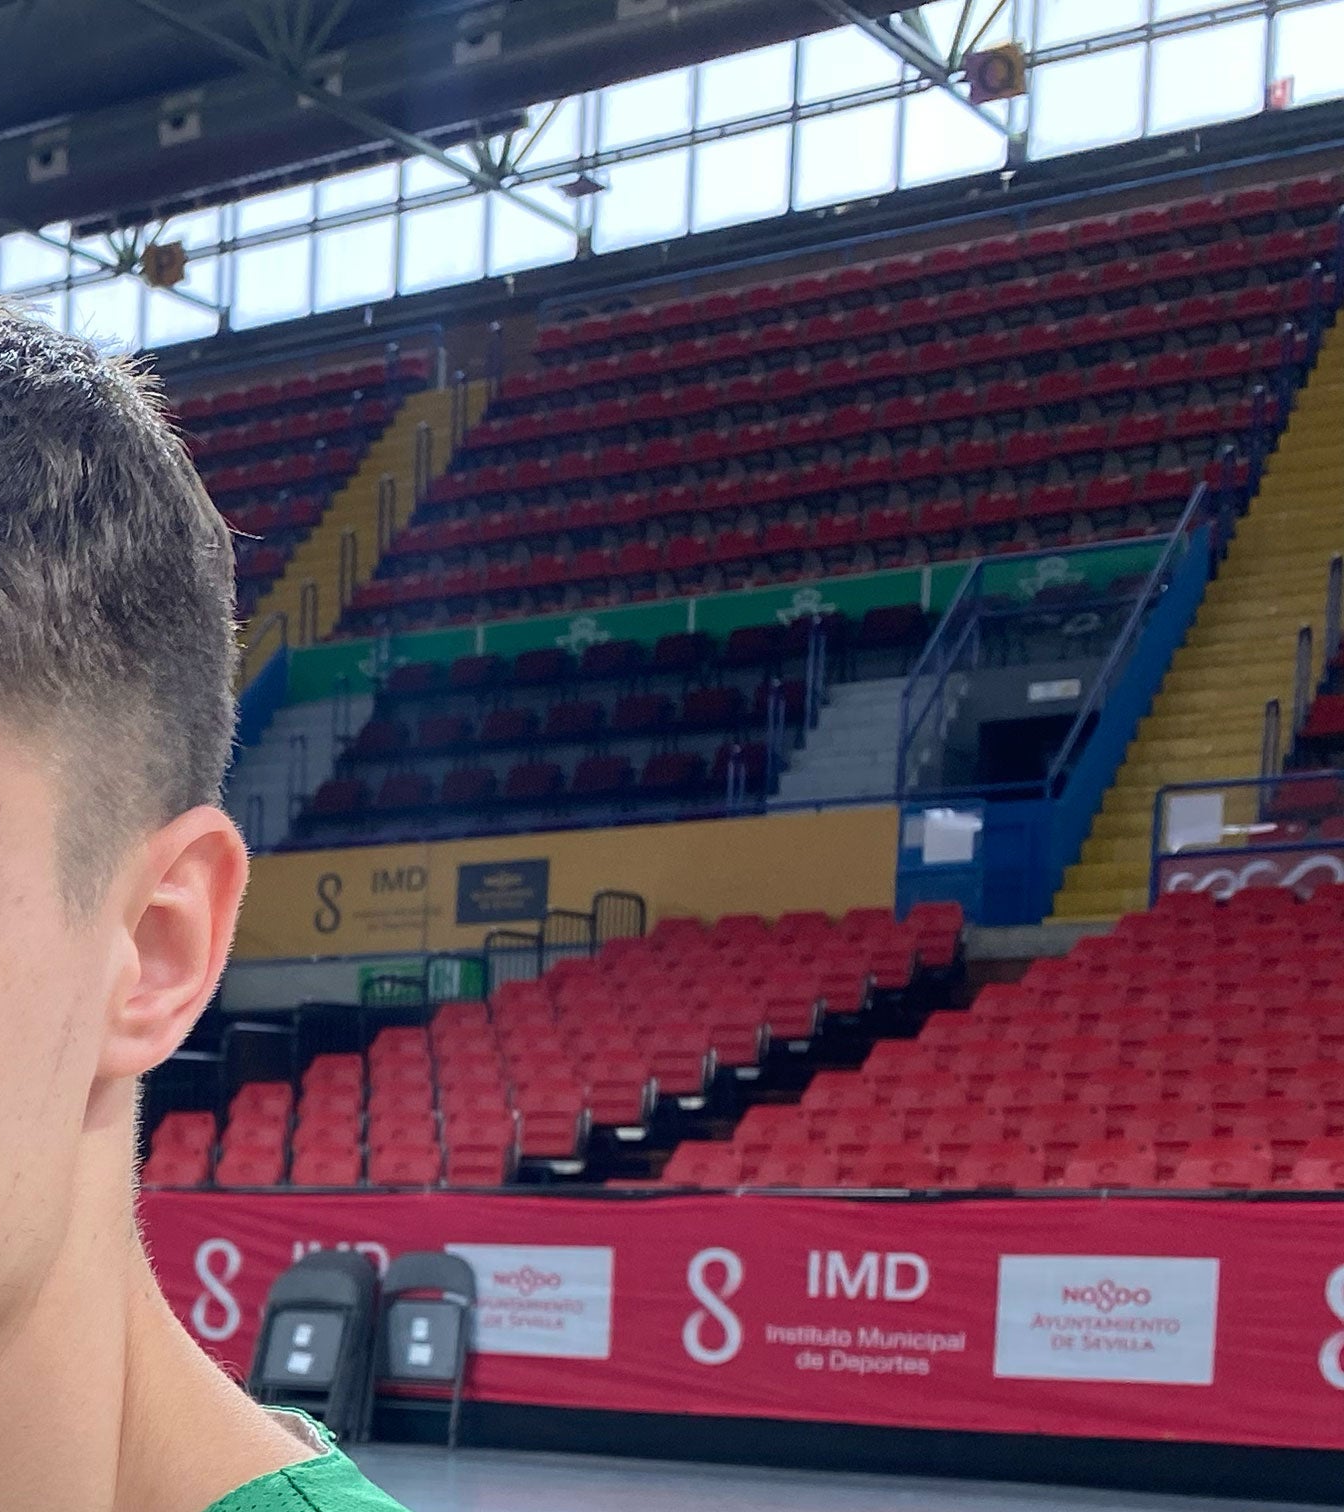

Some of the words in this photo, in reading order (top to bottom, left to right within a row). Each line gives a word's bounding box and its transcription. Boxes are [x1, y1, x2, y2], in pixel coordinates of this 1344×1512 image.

[372, 865, 428, 893] IMD
[806, 1249, 930, 1301] IMD
[765, 1323, 852, 1347] Instituto
[857, 1327, 966, 1354] Municipal
[1081, 1333, 1156, 1352] SEVILLA
[794, 1351, 824, 1370] de
[828, 1351, 931, 1376] Deportes
